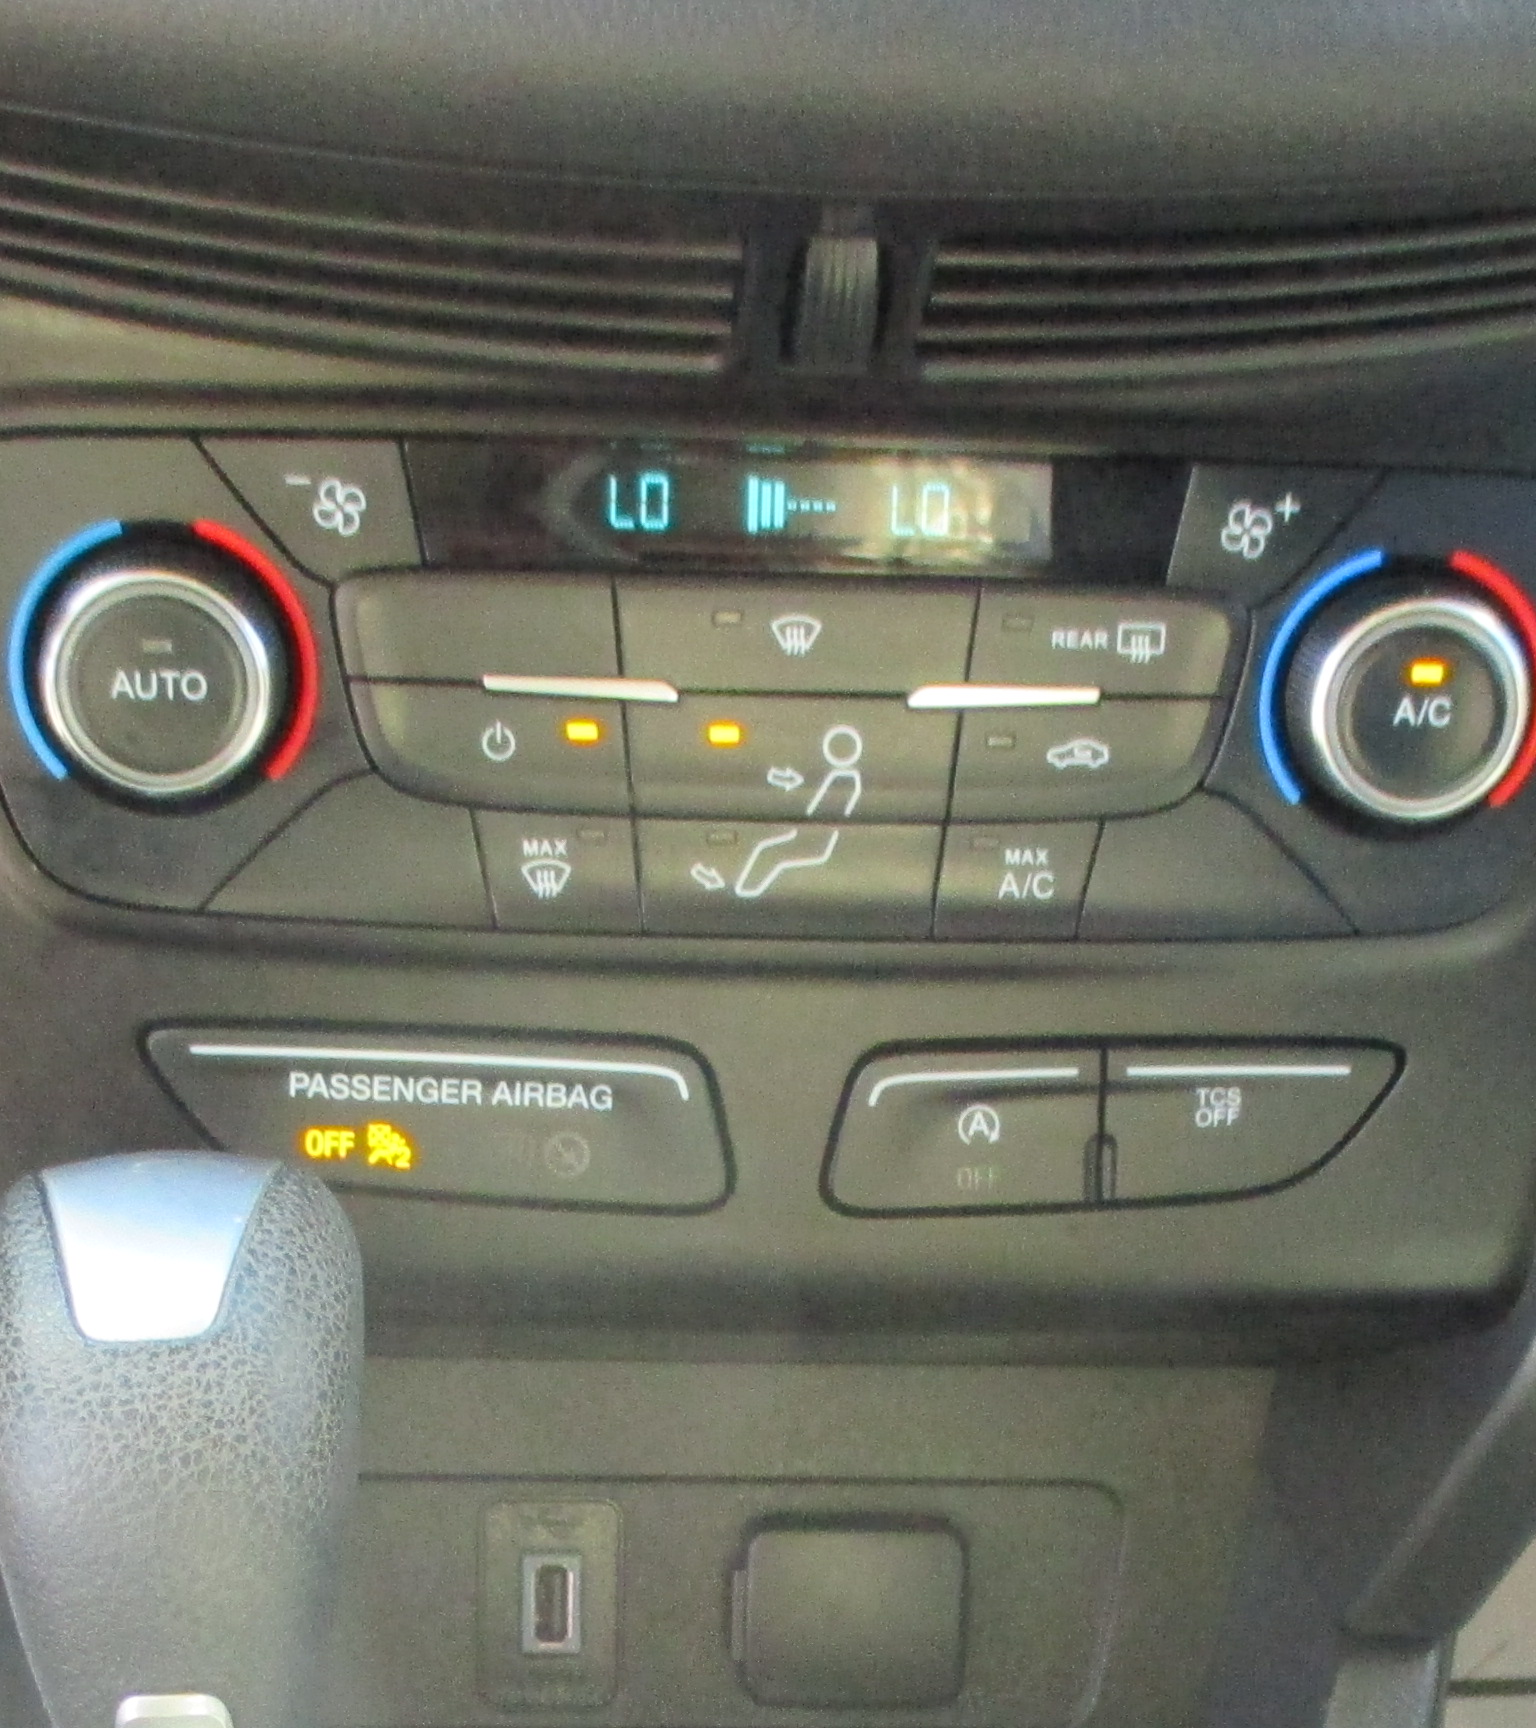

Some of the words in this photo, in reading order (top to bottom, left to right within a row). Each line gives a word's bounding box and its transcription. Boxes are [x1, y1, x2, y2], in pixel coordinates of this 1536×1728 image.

[607, 471, 669, 530] LO
[890, 482, 951, 537] LO
[1050, 628, 1109, 650] REAR
[110, 667, 208, 702] AUTO
[1393, 696, 1452, 728] A/C
[522, 839, 567, 857] MAX
[1003, 848, 1048, 866] MAX
[997, 869, 1055, 901] A/C
[288, 1070, 482, 1106] PASSENGER
[491, 1081, 613, 1112] AIRBAG
[1194, 1086, 1242, 1108] TCS
[1193, 1106, 1240, 1128] OFF
[304, 1129, 356, 1159] OFF
